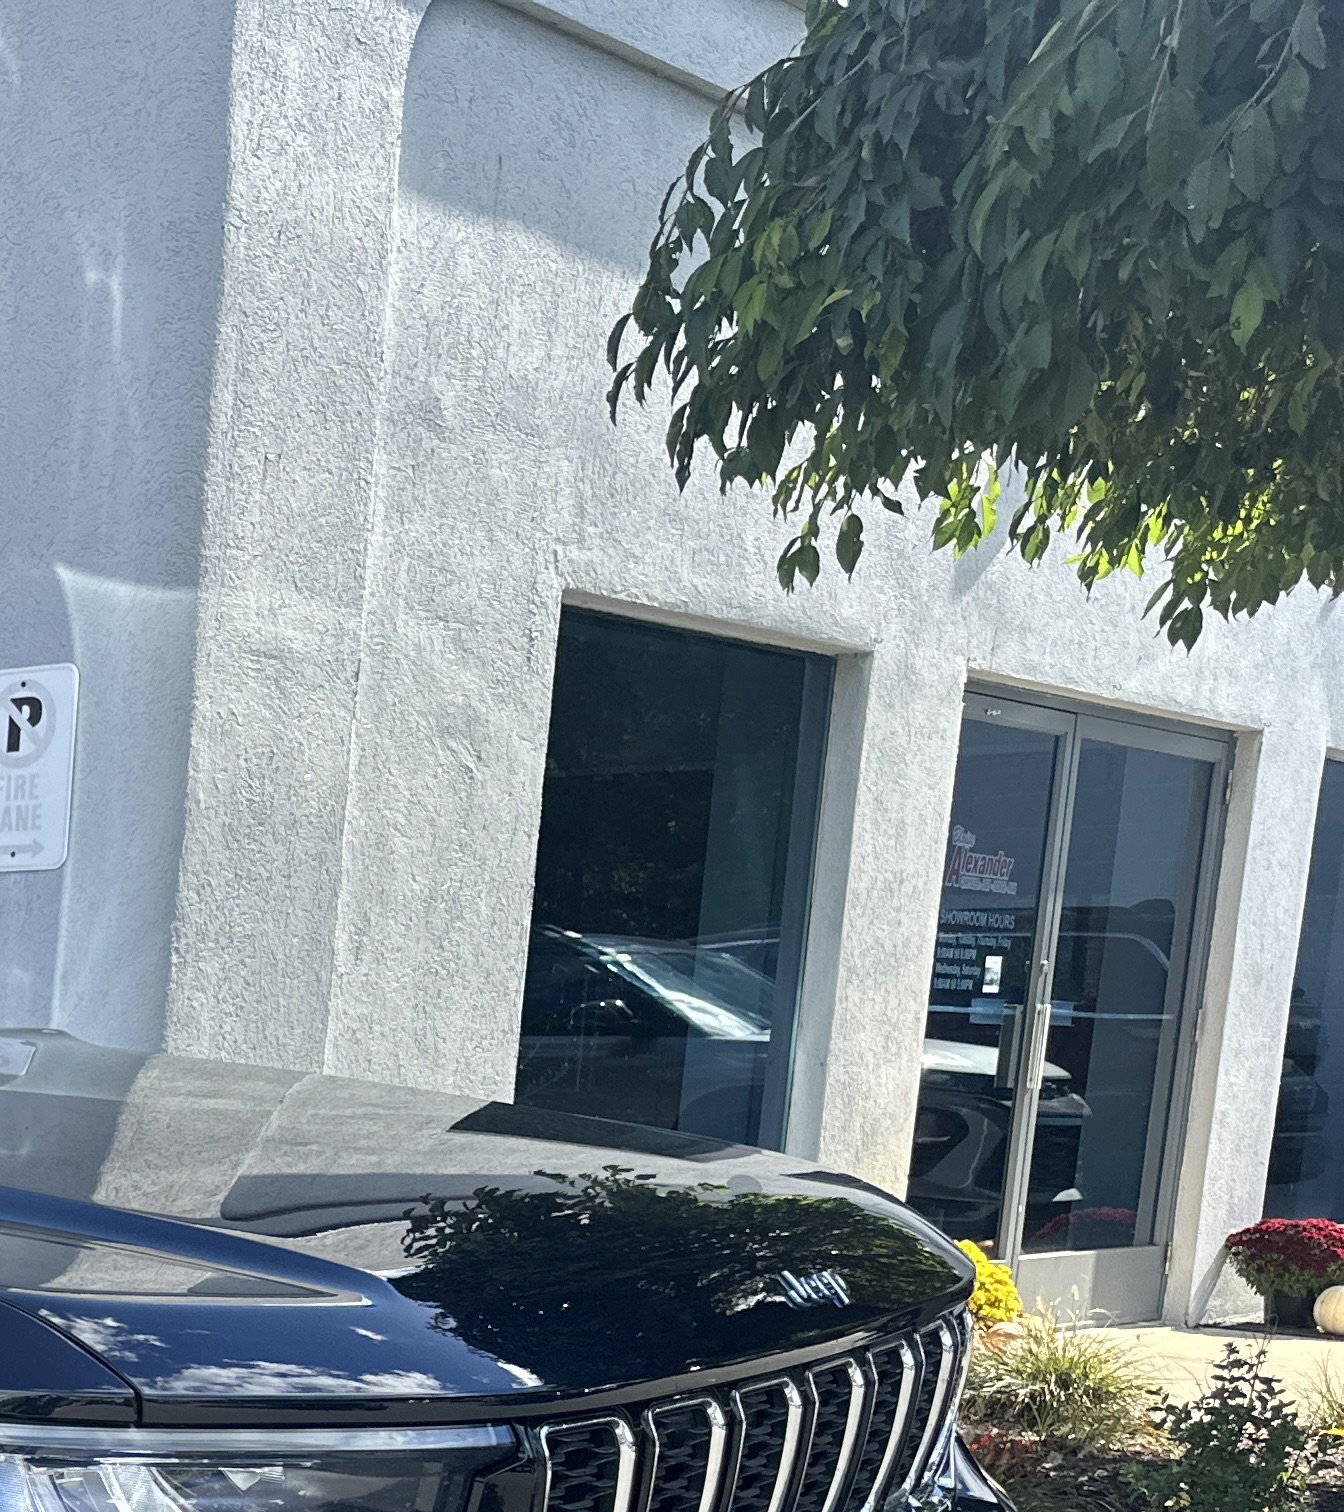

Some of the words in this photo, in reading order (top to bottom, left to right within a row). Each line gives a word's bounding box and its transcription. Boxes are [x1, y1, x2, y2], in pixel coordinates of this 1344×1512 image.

[947, 846, 1014, 886] Alexander
[939, 909, 987, 926] SHOWROOM
[988, 912, 1015, 929] HOURS
